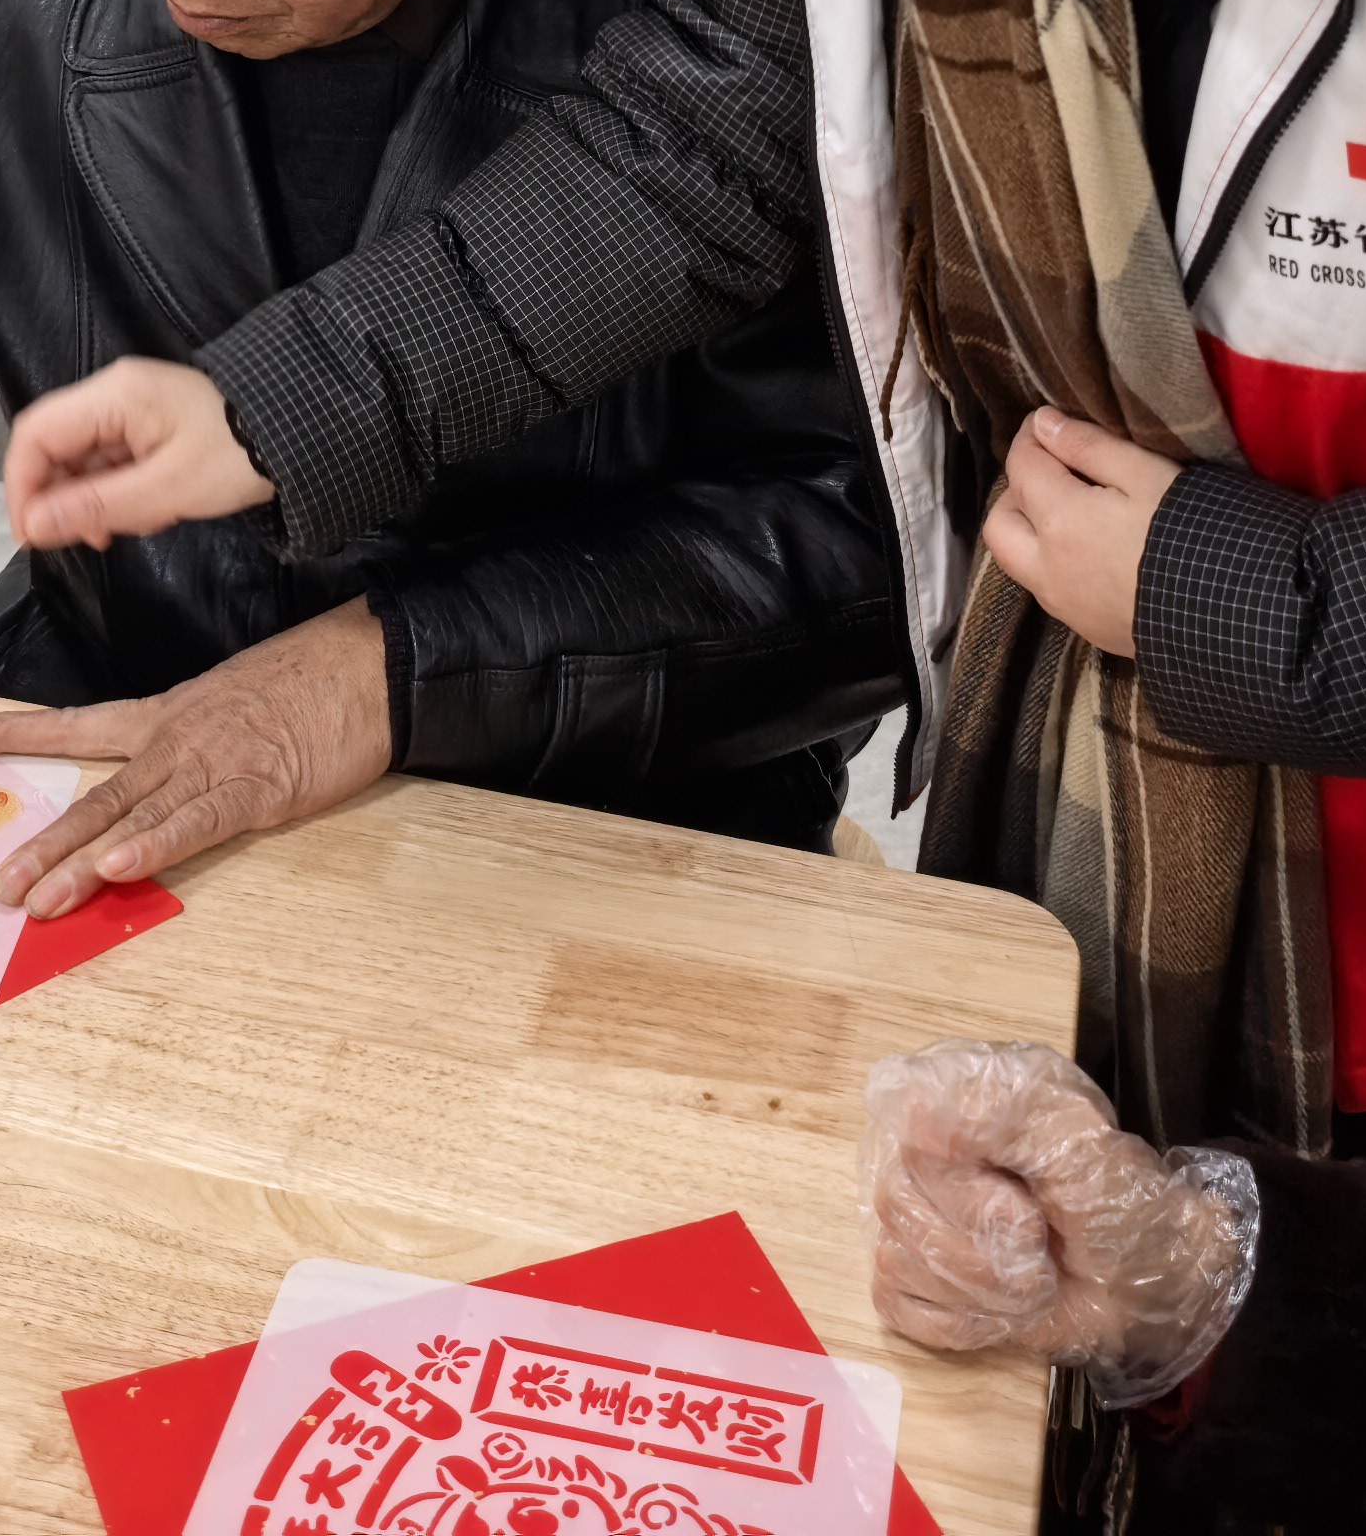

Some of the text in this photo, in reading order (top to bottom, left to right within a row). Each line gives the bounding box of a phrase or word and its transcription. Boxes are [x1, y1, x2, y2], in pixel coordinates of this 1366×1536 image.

[1268, 254, 1300, 280] RED
[1310, 265, 1366, 290] CROSS
[508, 1362, 786, 1463] 恭喜发财
